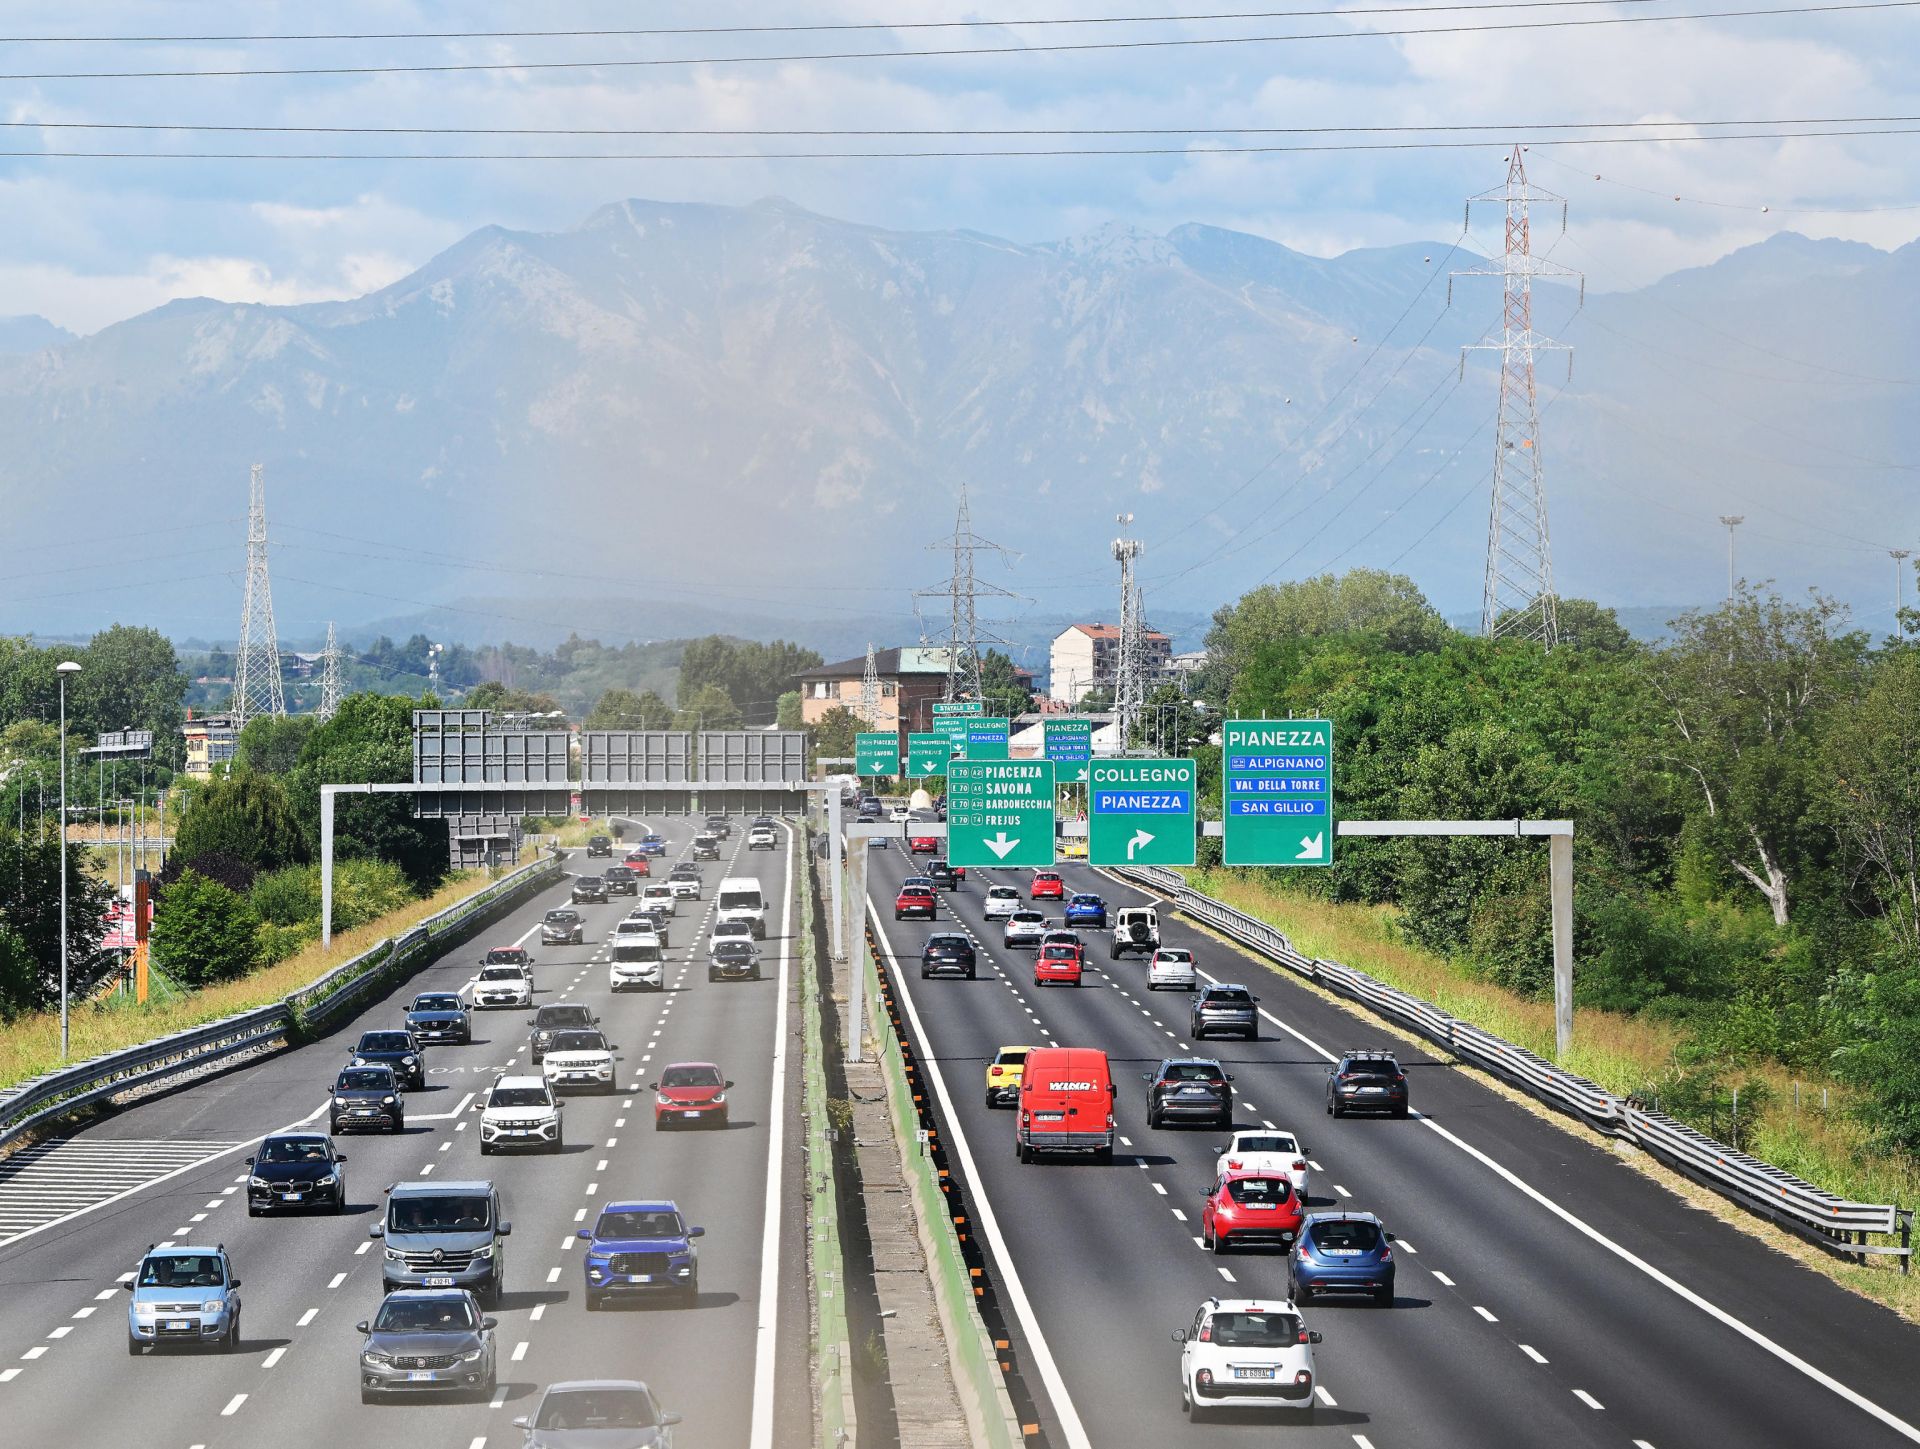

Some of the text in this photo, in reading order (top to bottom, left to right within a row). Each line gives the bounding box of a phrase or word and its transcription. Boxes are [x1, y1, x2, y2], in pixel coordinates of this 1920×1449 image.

[1046, 724, 1089, 732] PIANEZZA
[1229, 731, 1326, 747] PIANEZZA
[1248, 758, 1325, 769] ALPIGNANO
[985, 766, 1042, 778] PIACENZA
[1094, 768, 1190, 782] COLLEGNO
[985, 782, 1032, 794] SAVONA
[1235, 780, 1320, 791] VAL DELLA TORRE
[985, 799, 1052, 810] BARDONECCHIA
[1102, 795, 1182, 809] PIANEZZA
[1241, 802, 1314, 813] SAN GILLIO
[985, 815, 1021, 826] FREJUS
